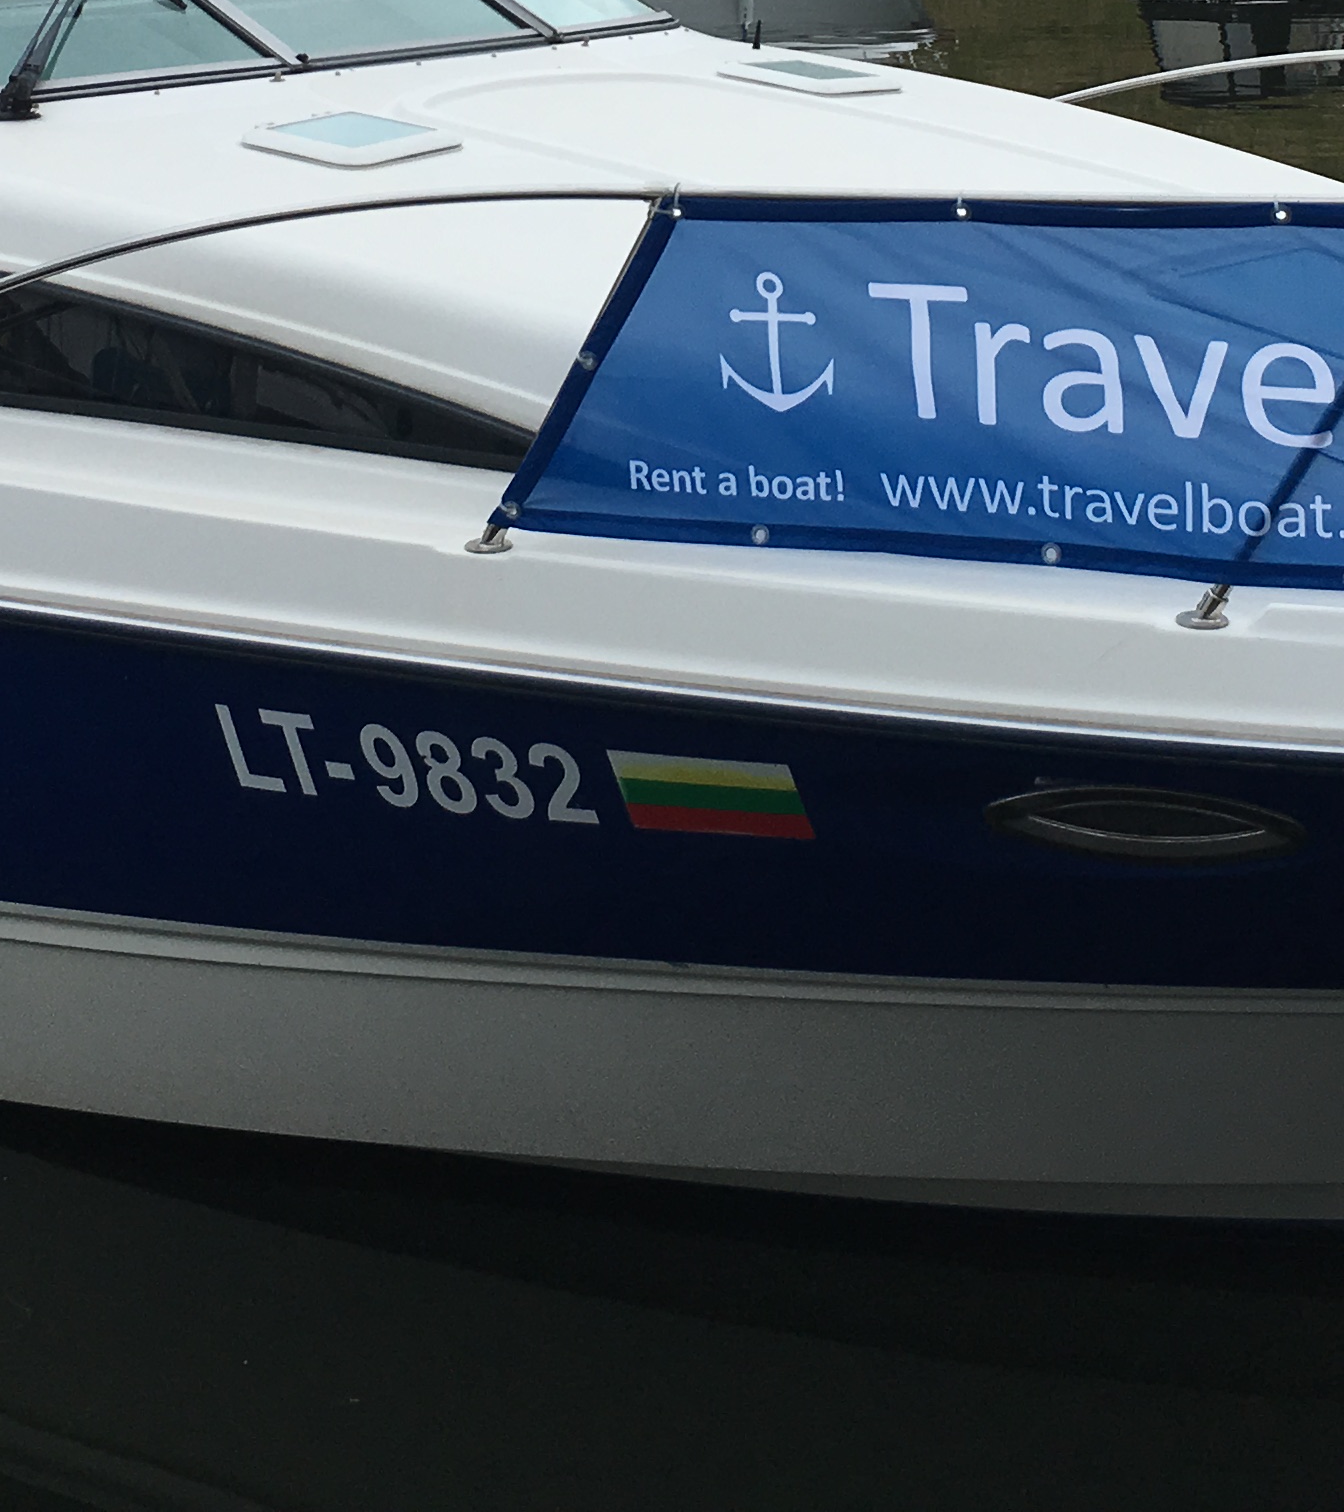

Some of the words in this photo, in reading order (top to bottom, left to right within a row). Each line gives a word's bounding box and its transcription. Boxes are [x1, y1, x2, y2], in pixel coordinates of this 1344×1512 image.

[628, 459, 707, 497] Rent
[717, 471, 739, 498] a
[748, 465, 846, 502] boat!
[214, 703, 600, 825] LT-9832
